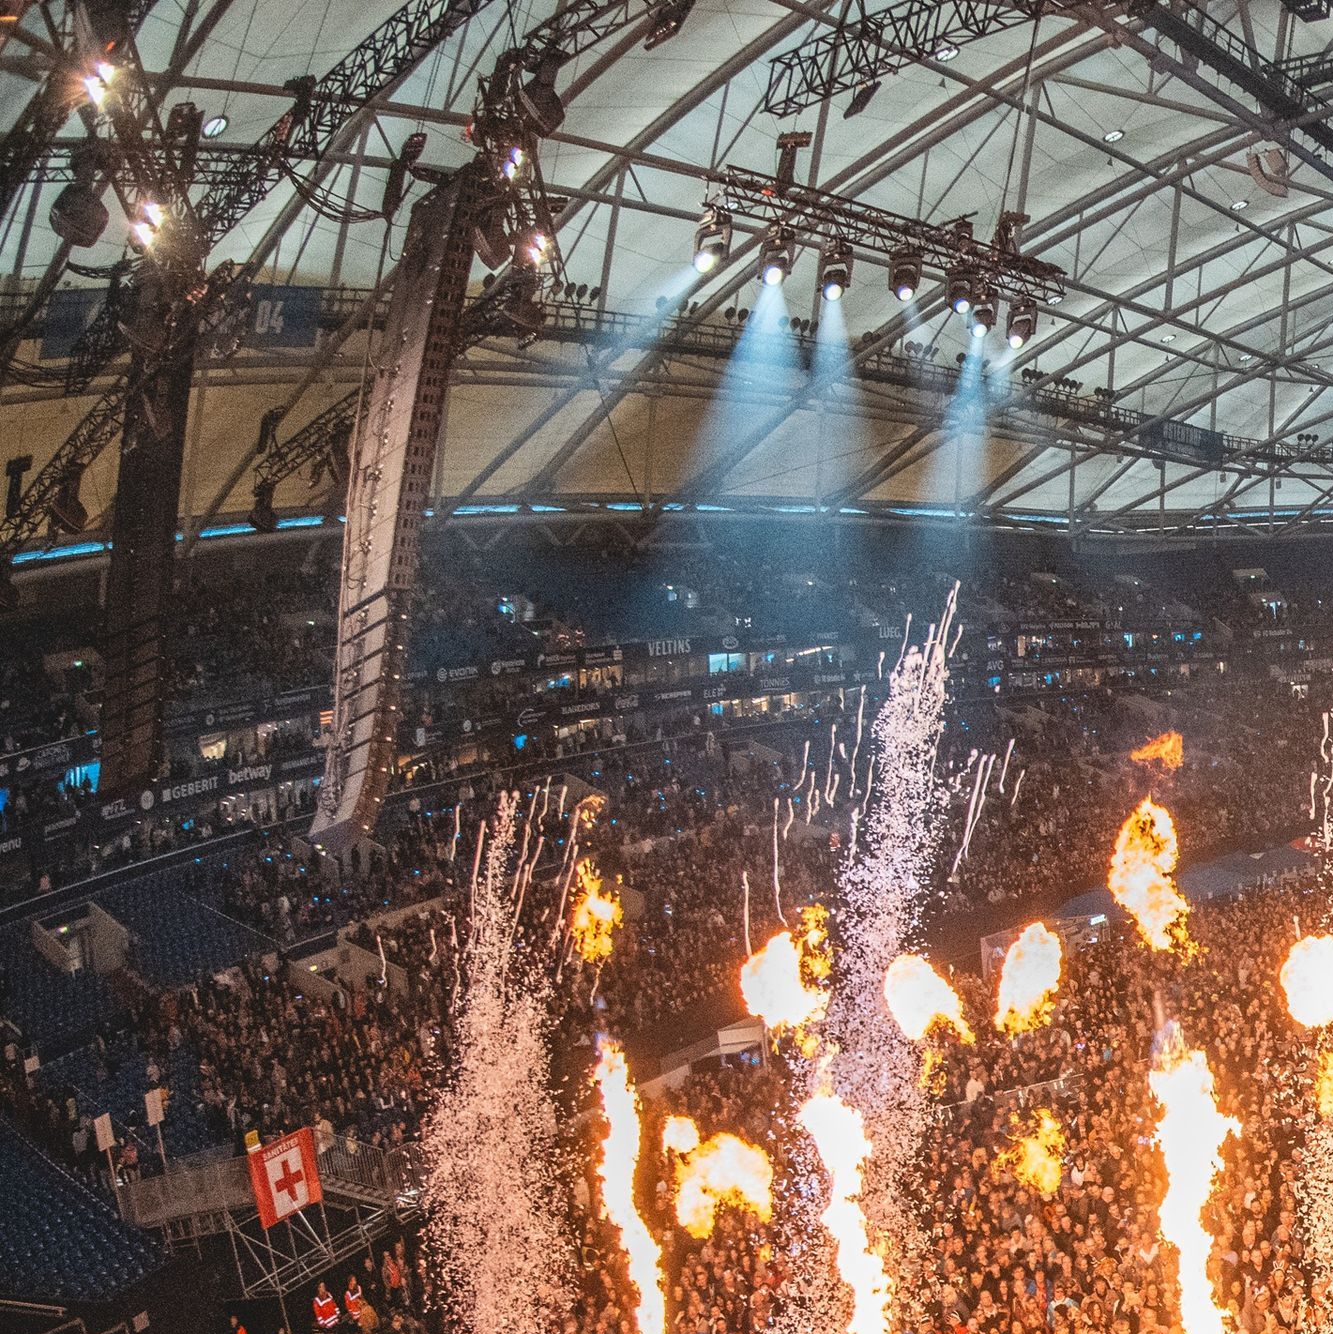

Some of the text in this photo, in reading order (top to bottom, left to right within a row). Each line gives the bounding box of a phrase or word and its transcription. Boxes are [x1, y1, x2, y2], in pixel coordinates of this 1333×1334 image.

[255, 300, 284, 334] 04
[648, 639, 691, 656] VELTINS
[228, 764, 273, 785] betway
[171, 776, 219, 799] GEBERIT
[0, 837, 22, 853] enu
